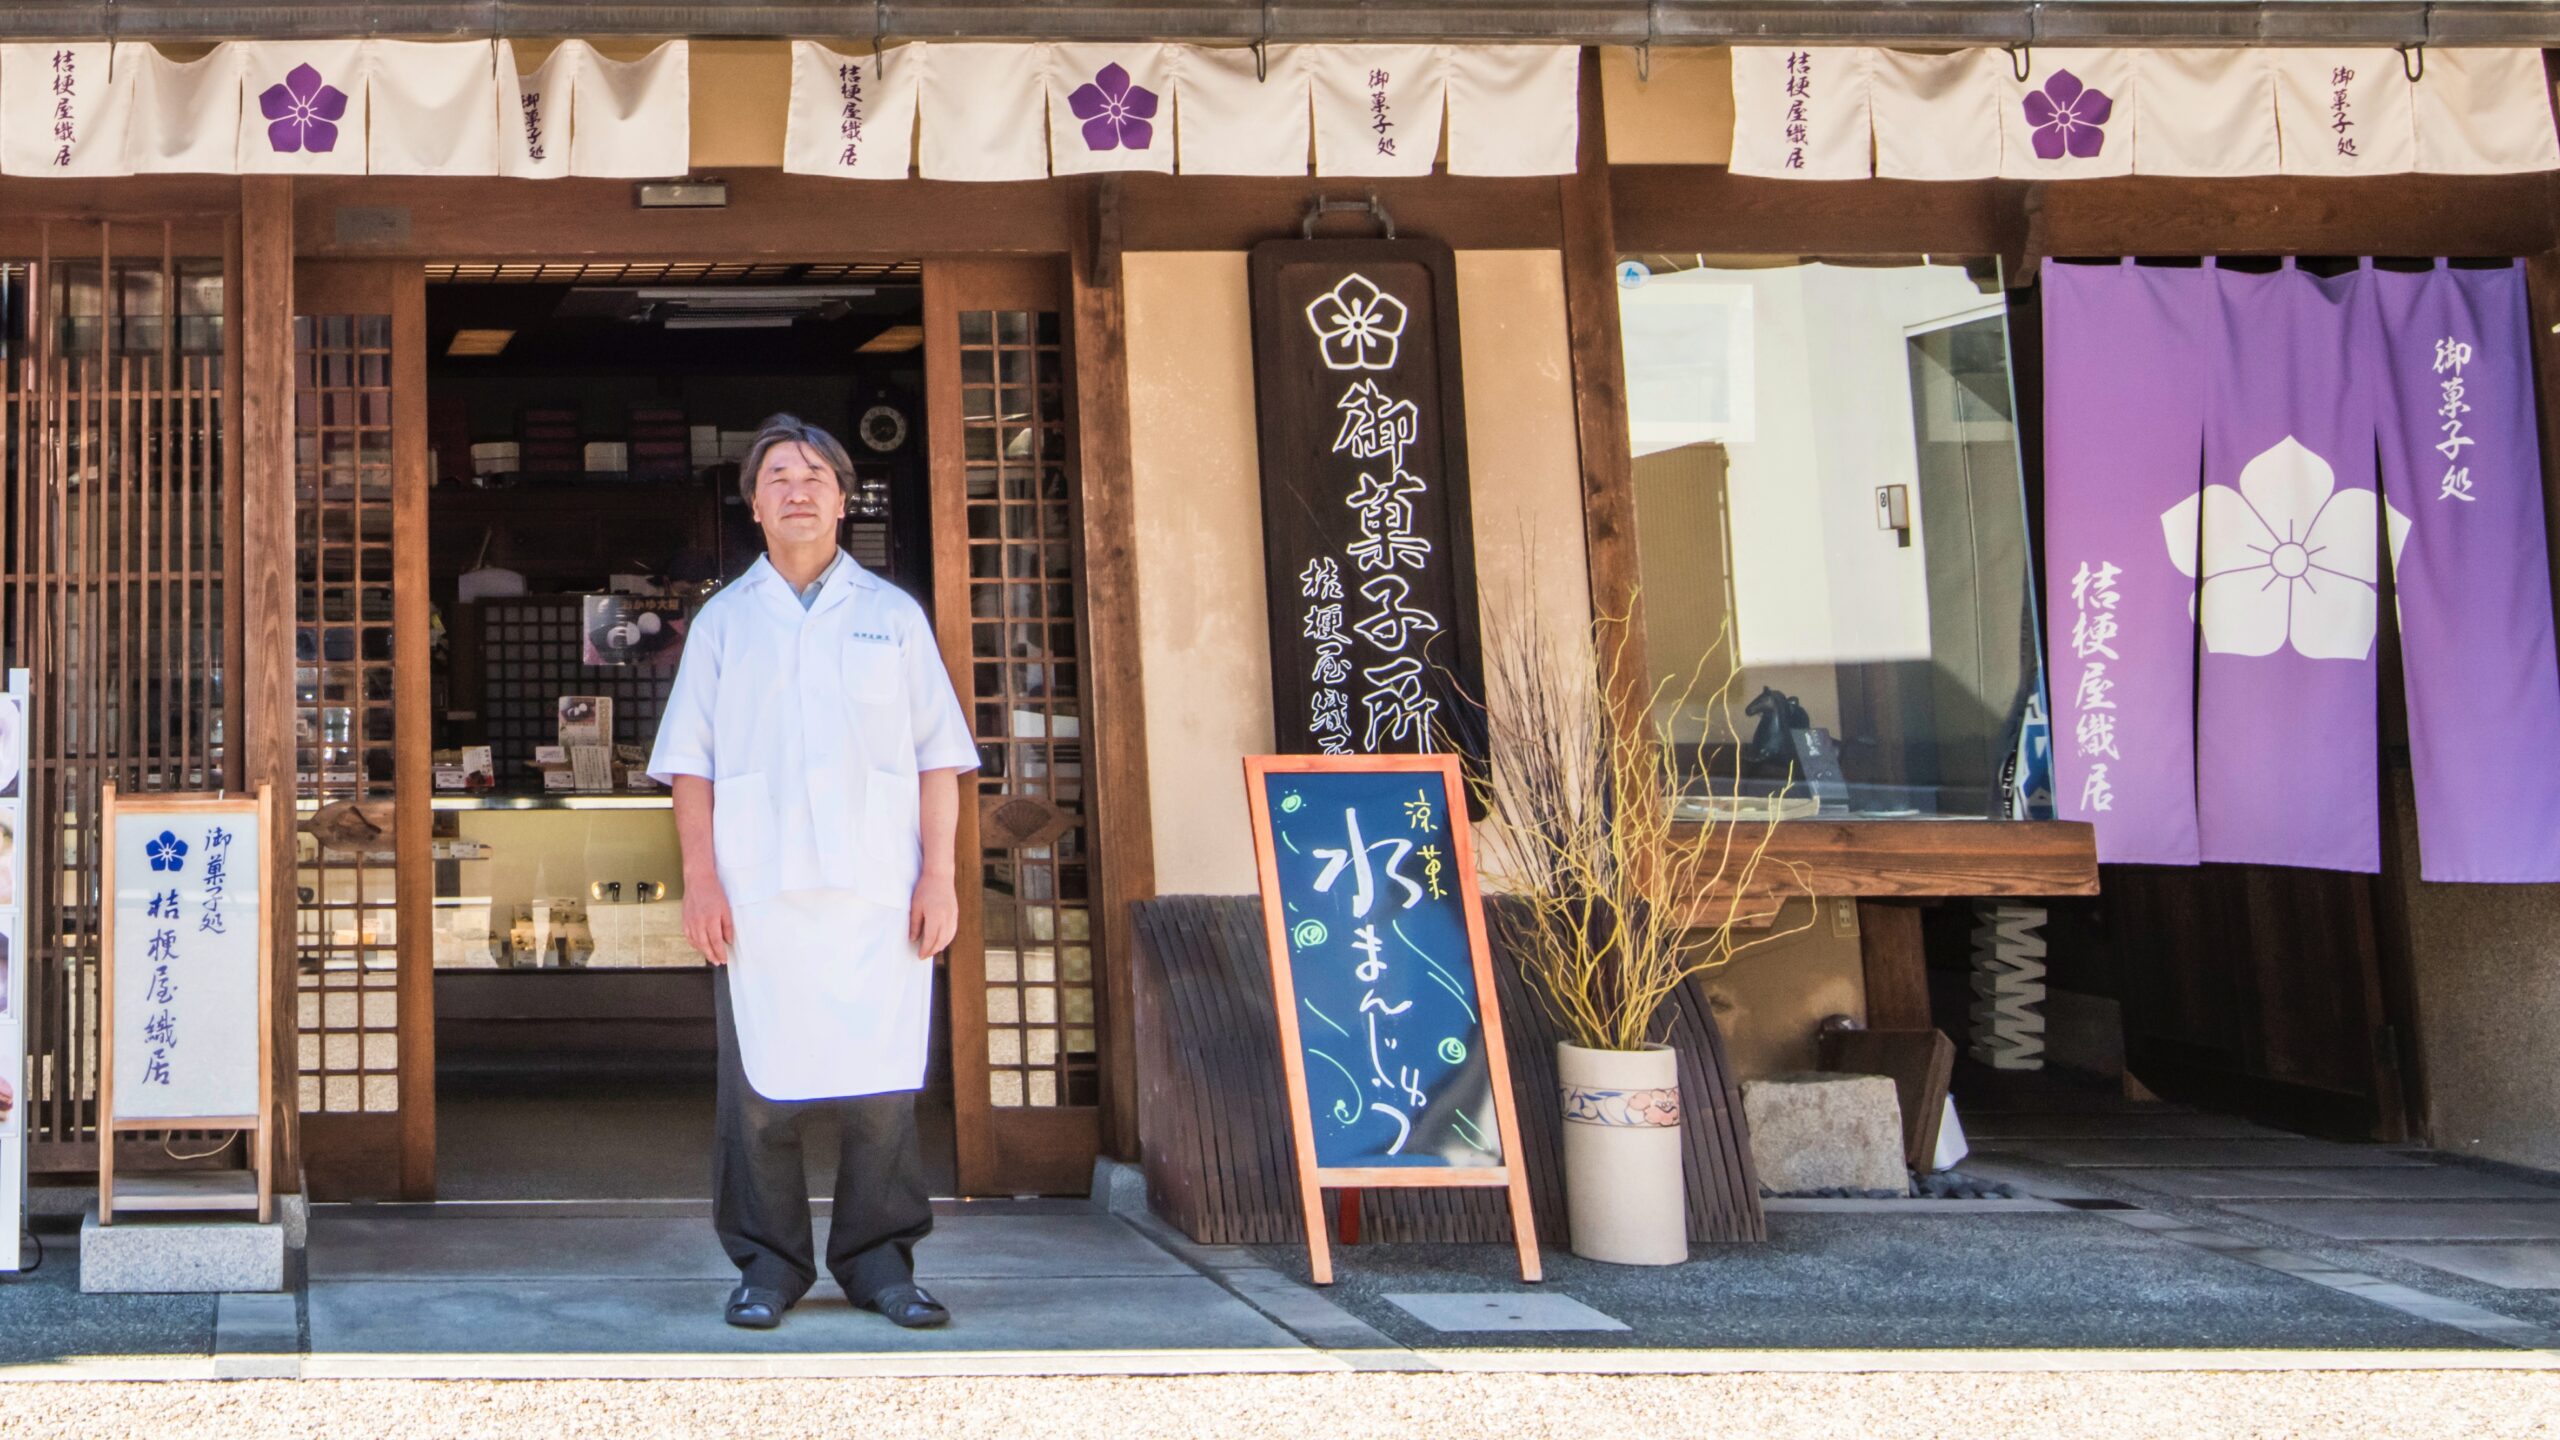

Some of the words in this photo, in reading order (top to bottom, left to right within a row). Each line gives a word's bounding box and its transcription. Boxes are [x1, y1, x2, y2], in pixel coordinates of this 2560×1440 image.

[52, 50, 76, 167] 桔梗屋織居
[839, 63, 863, 166] 桔梗屋織居
[1368, 68, 1396, 157] 御菓子処
[1785, 51, 1811, 169] 桔梗屋織居
[2331, 66, 2359, 157] 御菓子処
[2432, 337, 2476, 503] 御菓子処
[1332, 378, 1440, 755] 御菓子所
[2071, 560, 2123, 812] 桔梗屋織居
[199, 826, 233, 935] 御菓子処
[1403, 788, 1447, 900] 涼菓
[143, 888, 181, 1086] 桔梗屋織居
[1312, 807, 1426, 1156] 水まんじゅう
